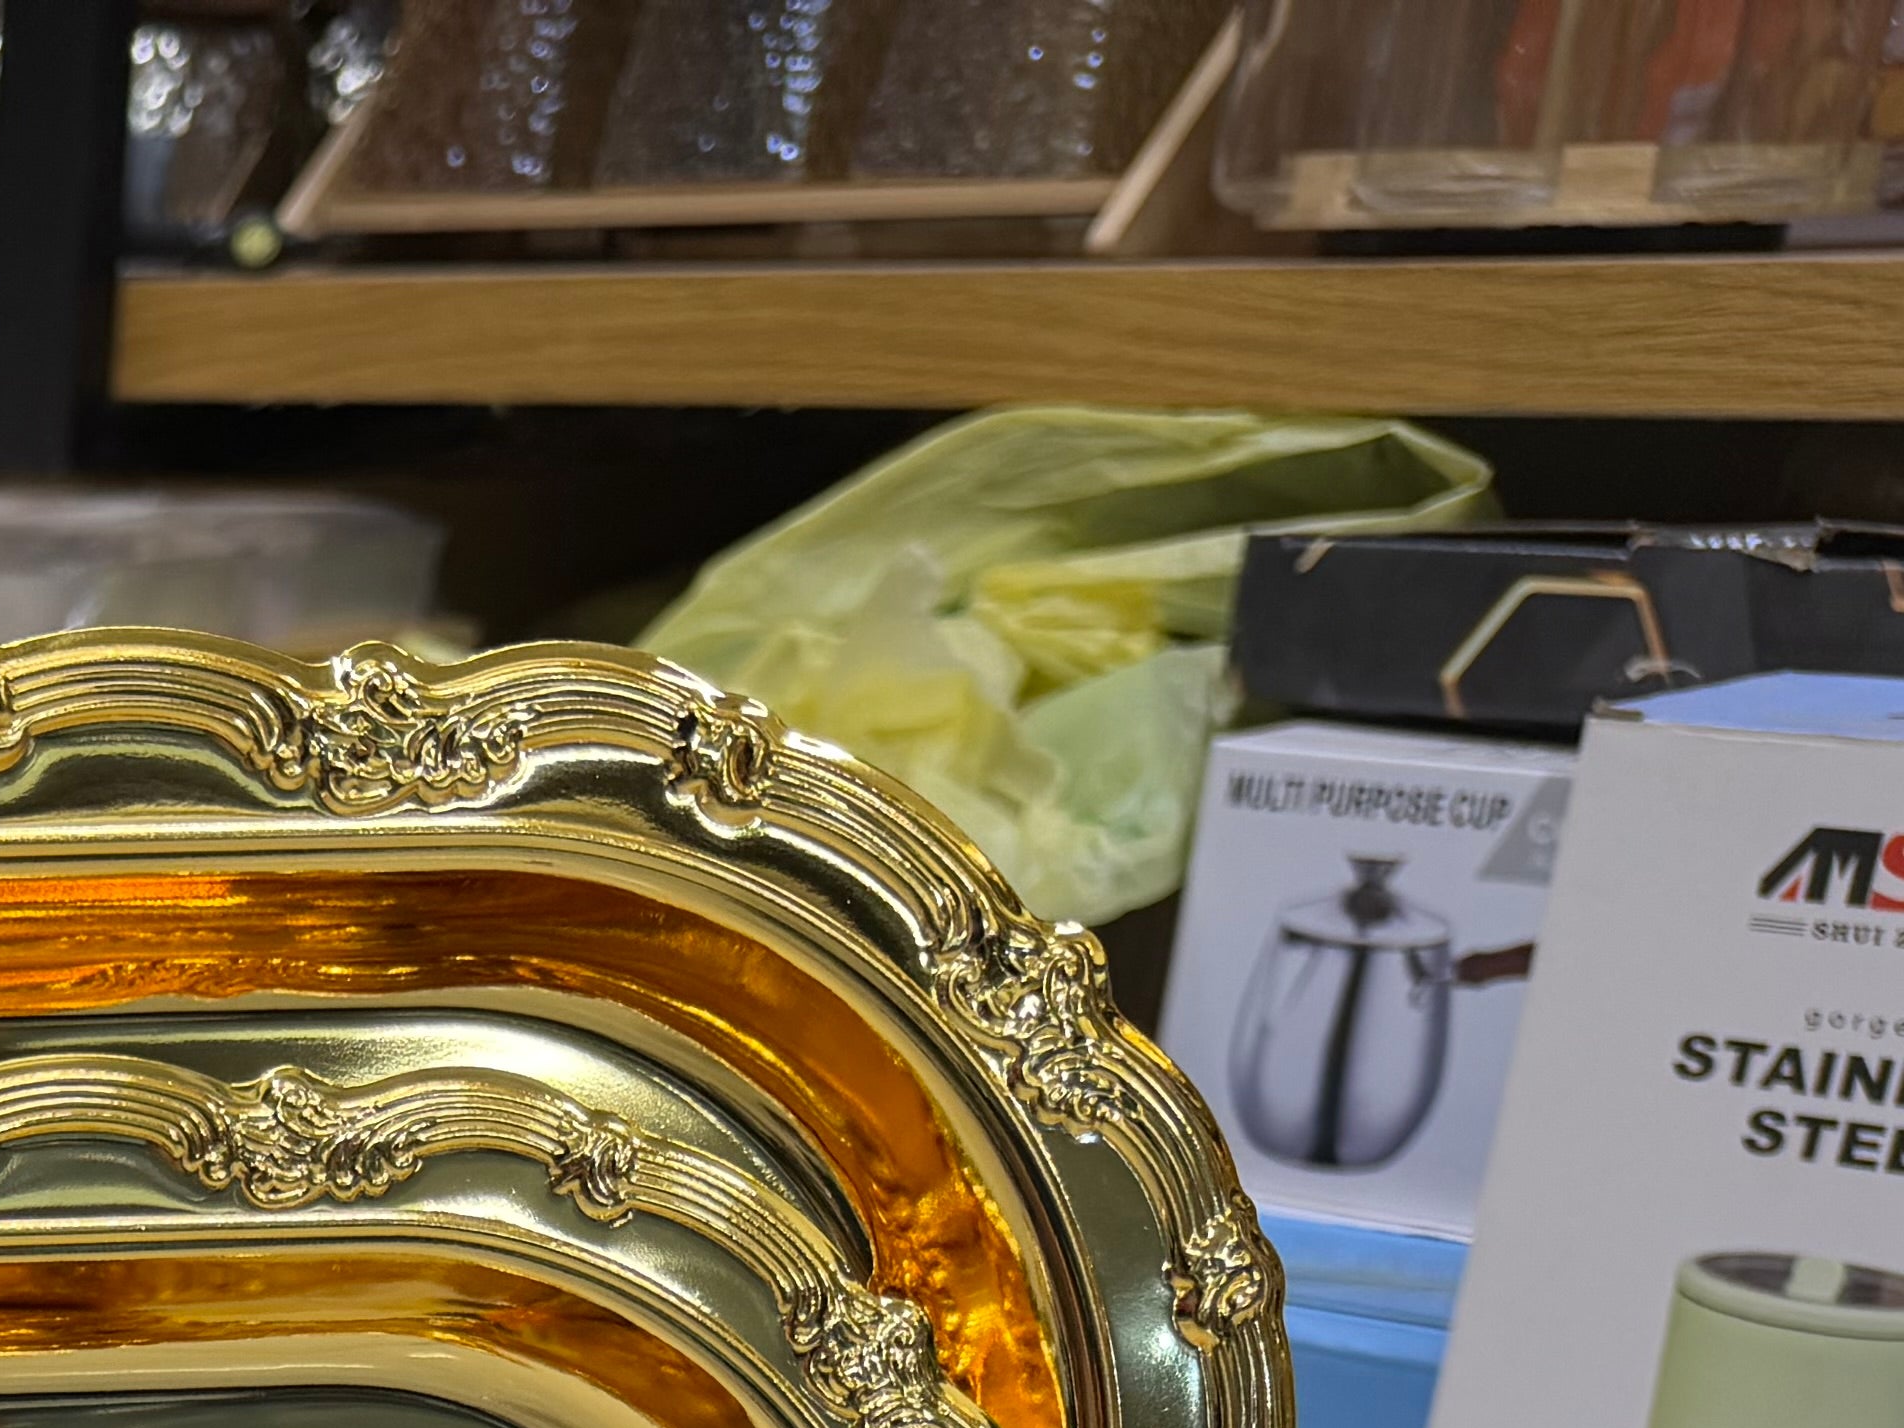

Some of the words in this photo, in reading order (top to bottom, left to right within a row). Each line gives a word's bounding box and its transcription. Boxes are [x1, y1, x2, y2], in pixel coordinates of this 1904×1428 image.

[1448, 787, 1512, 832] CUP
[1810, 918, 1885, 948] SHUI
[1672, 1032, 1904, 1108] STAIN
